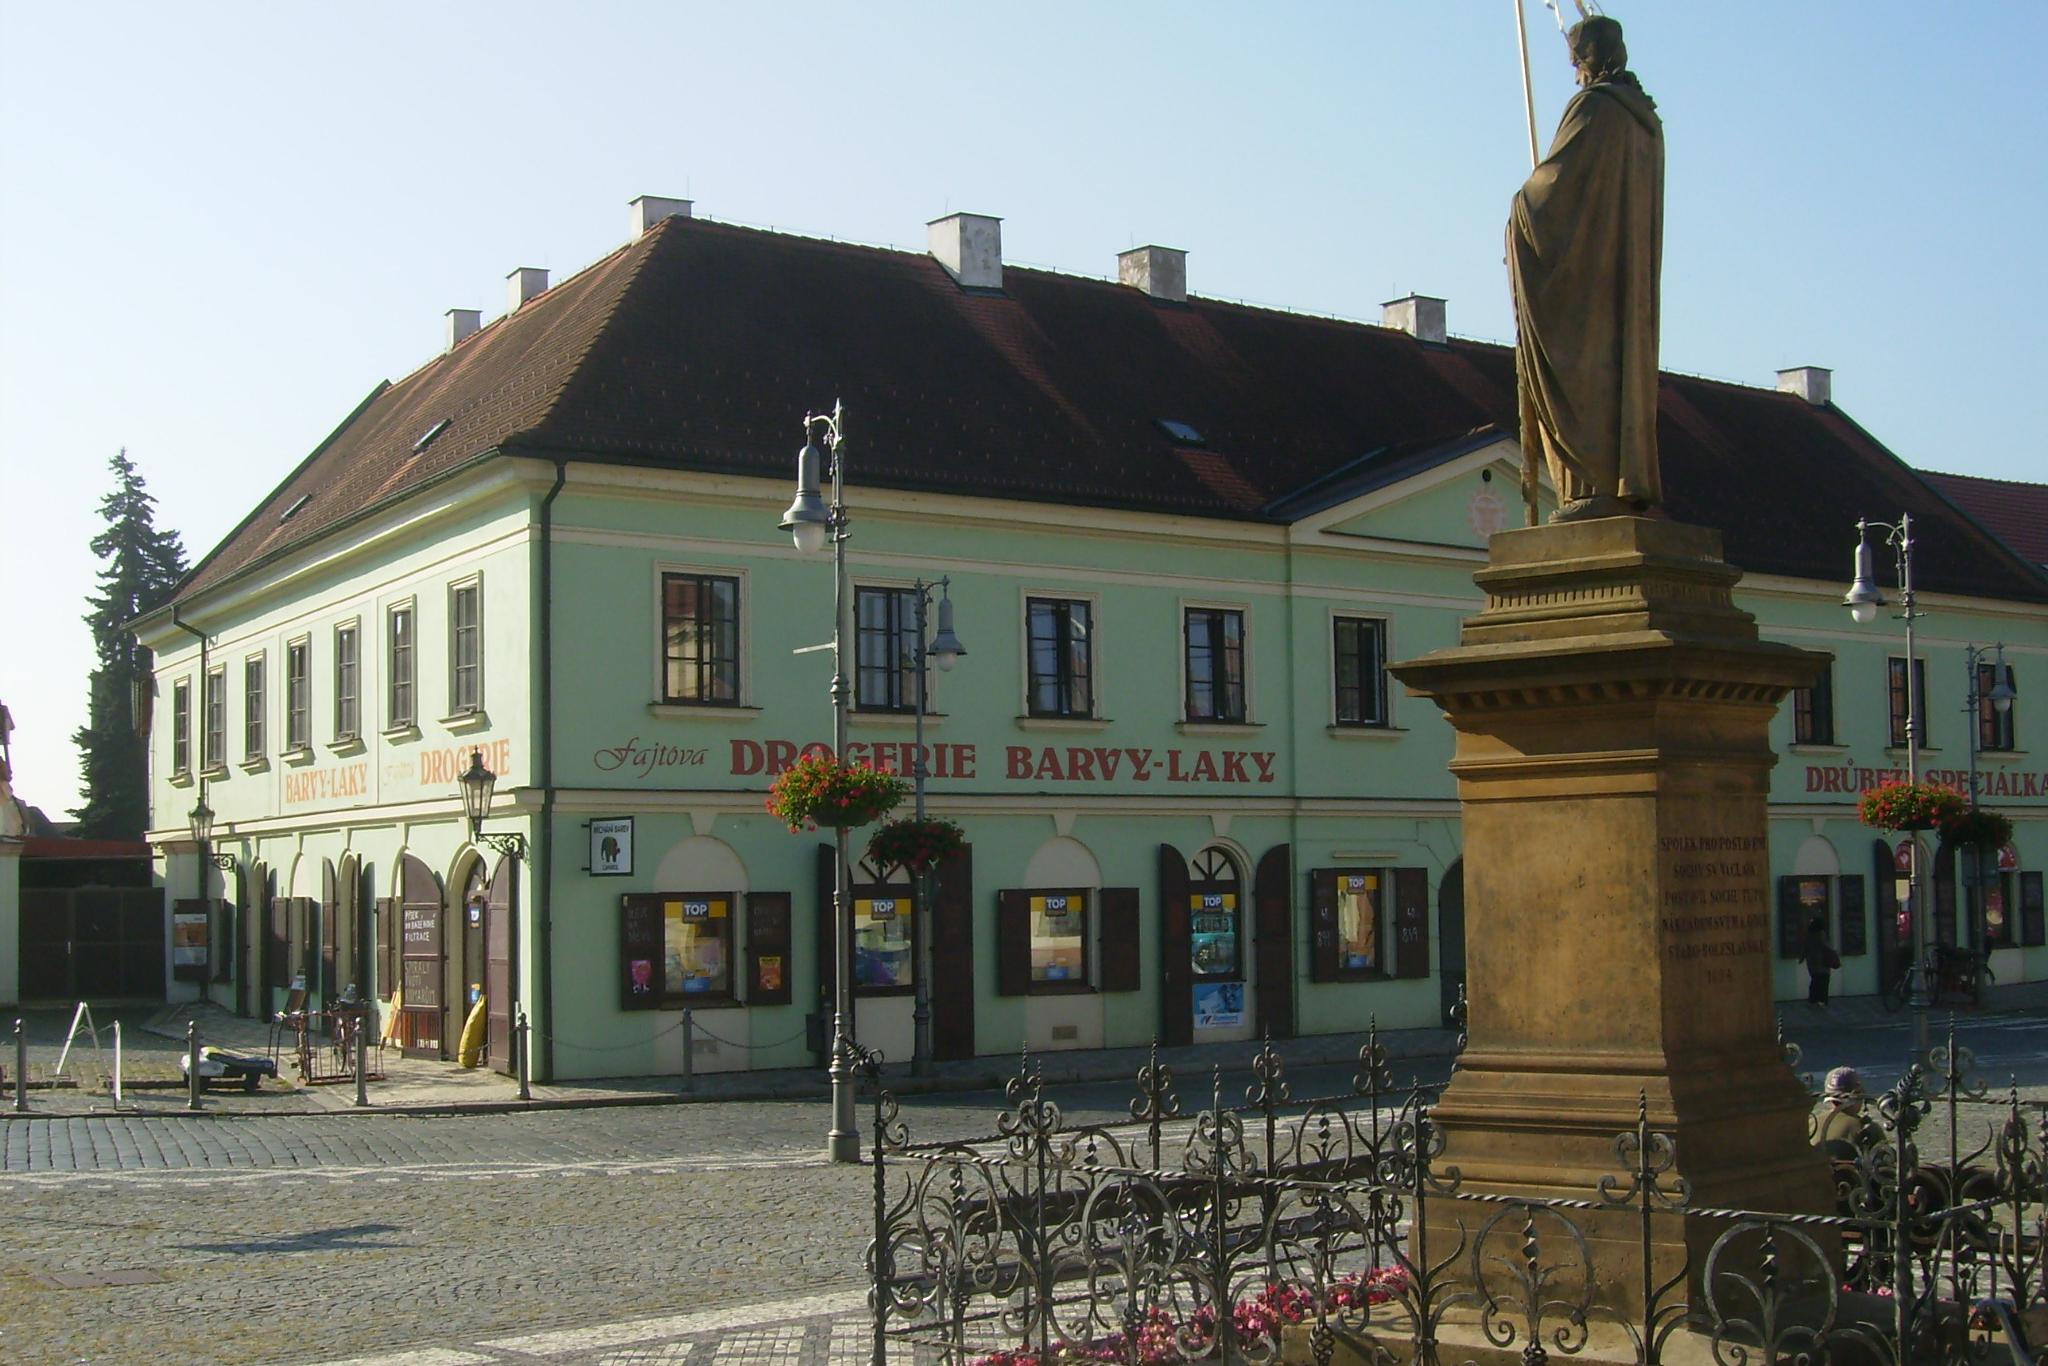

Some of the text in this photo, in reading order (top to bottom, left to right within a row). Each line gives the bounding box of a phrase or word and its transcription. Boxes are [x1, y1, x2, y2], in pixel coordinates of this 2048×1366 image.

[1005, 746, 1276, 782] BARVY-LAKY
[1348, 878, 1364, 888] TOP
[873, 902, 894, 912] TOP
[1046, 898, 1066, 909] TOP
[1203, 896, 1222, 907] TOP
[684, 904, 708, 916] TOP
